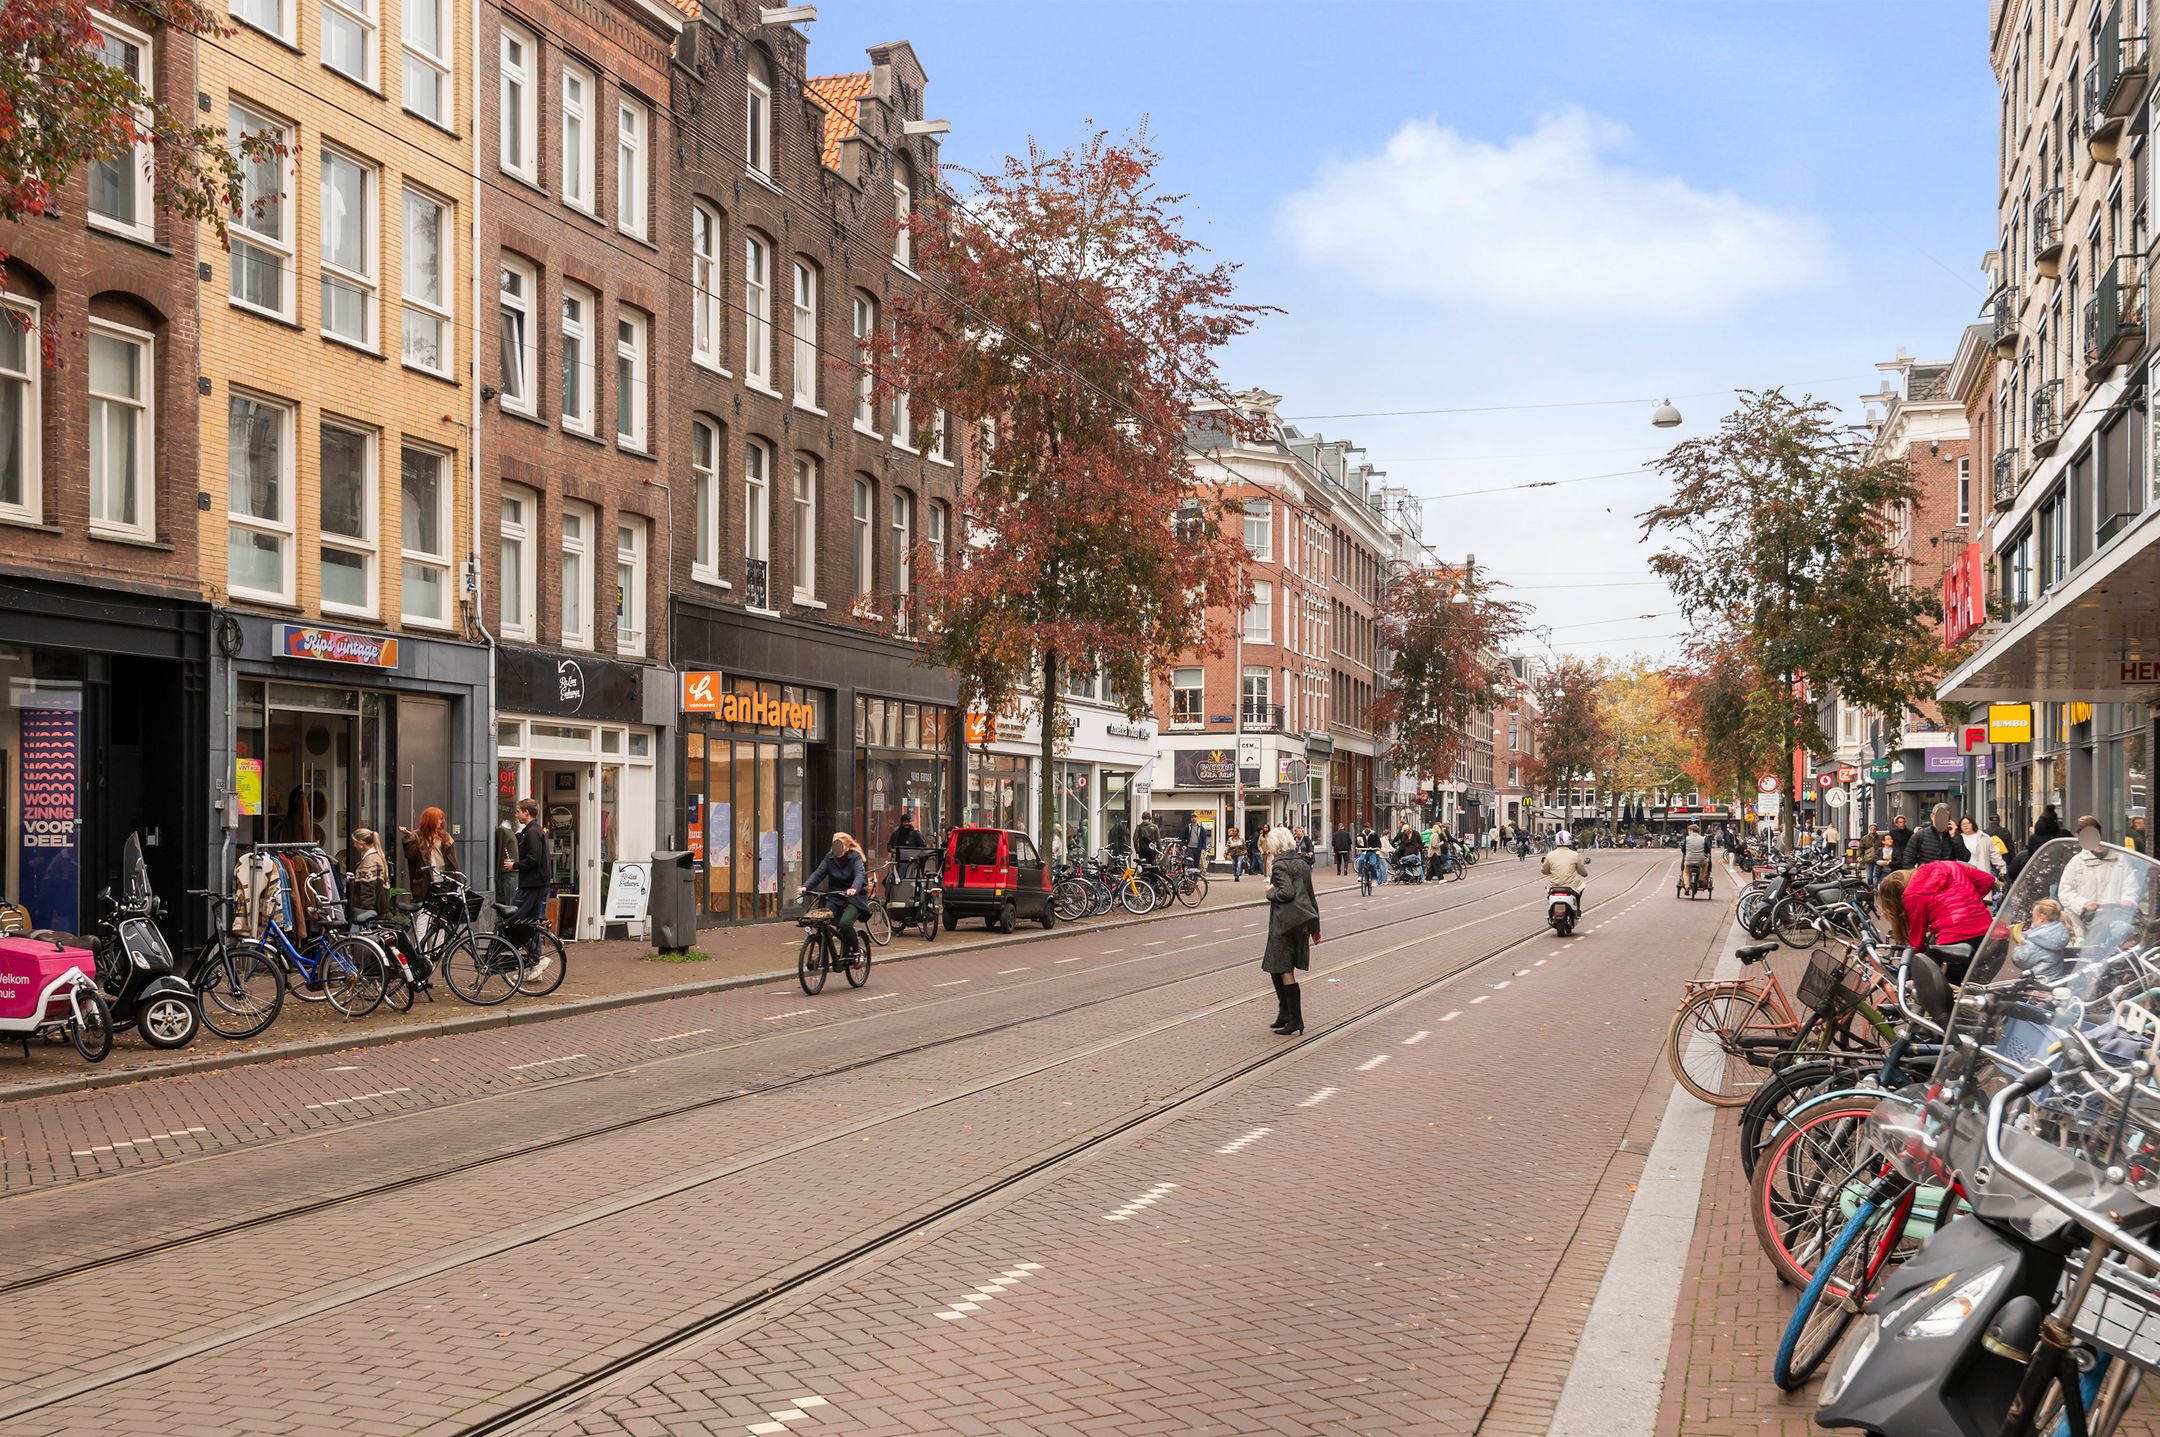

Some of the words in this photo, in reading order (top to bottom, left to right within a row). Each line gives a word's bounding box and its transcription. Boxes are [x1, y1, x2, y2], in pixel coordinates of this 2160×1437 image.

[304, 632, 335, 656] Rips
[337, 638, 379, 662] vintage
[1965, 728, 1985, 751] F
[24, 793, 74, 806] WOON
[24, 807, 74, 820] ZINNIG
[24, 821, 74, 834] VOOR
[24, 835, 74, 847] DEEL
